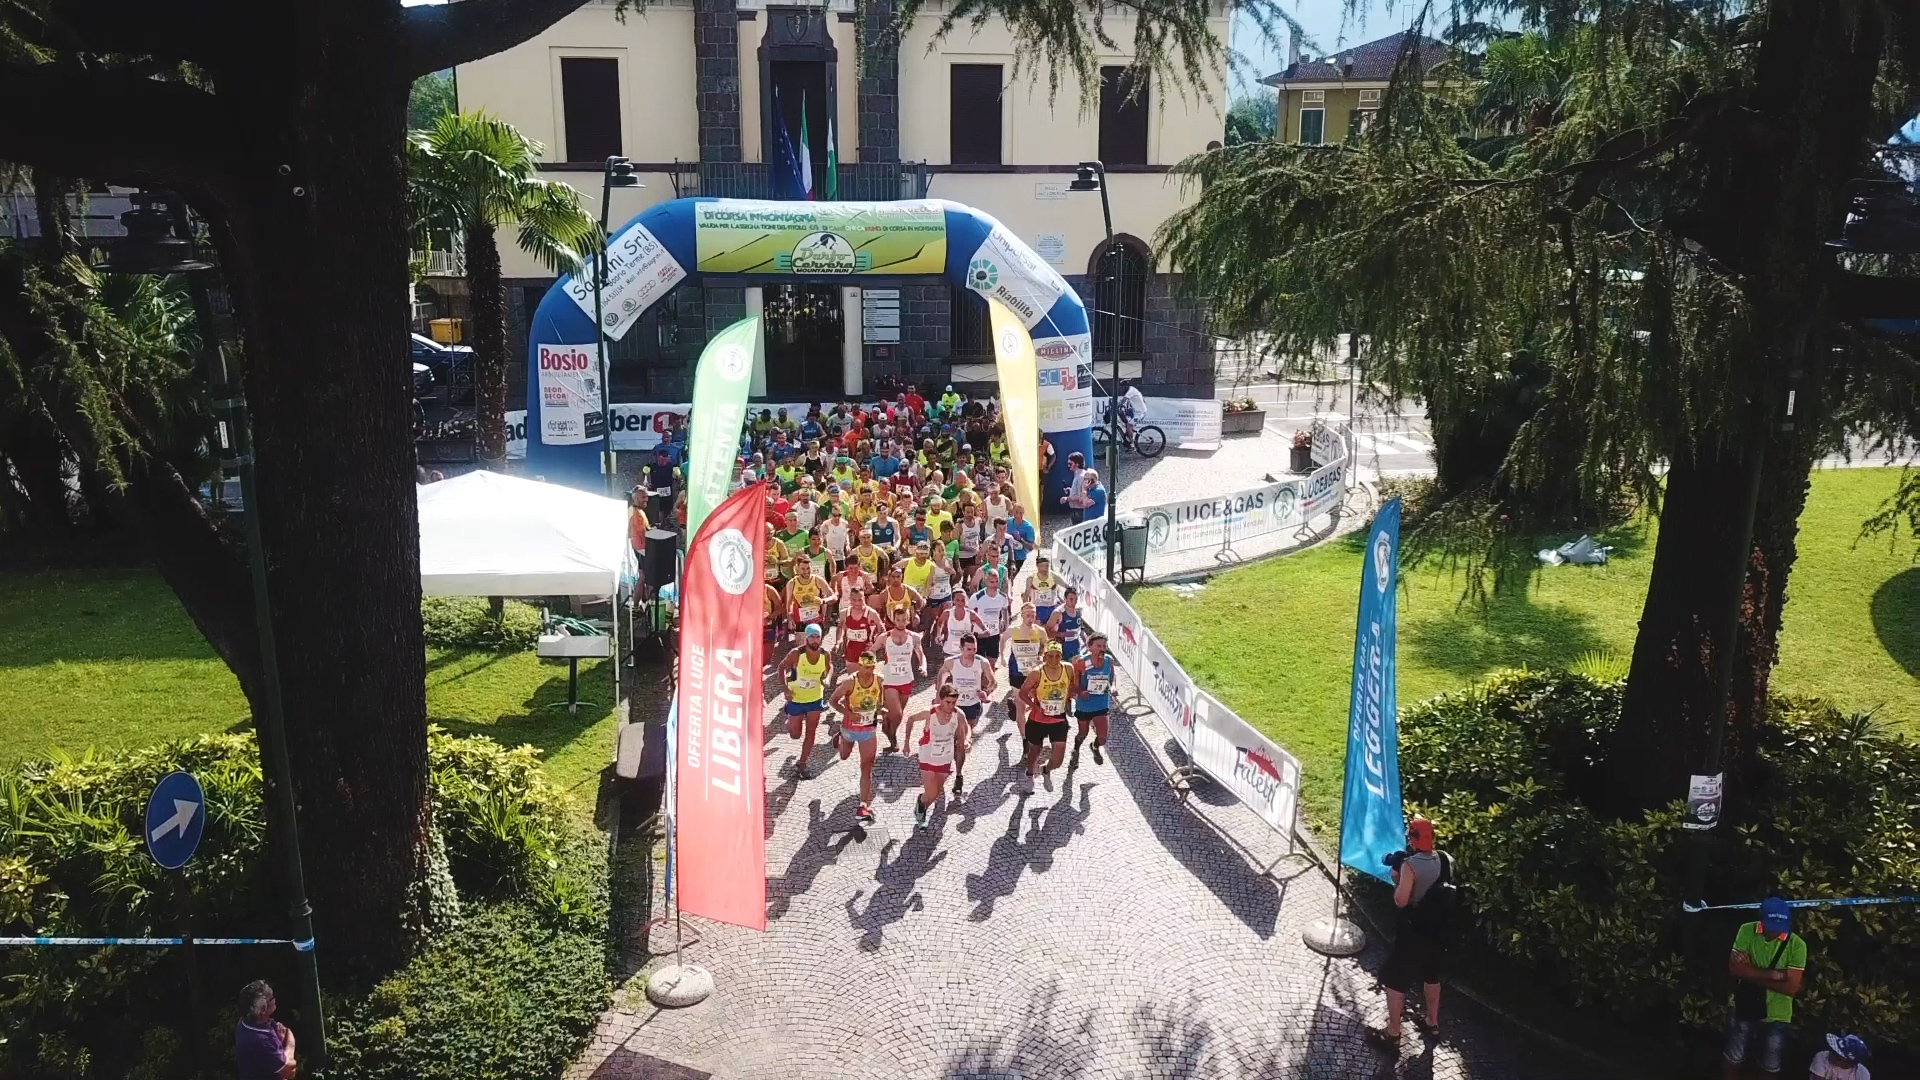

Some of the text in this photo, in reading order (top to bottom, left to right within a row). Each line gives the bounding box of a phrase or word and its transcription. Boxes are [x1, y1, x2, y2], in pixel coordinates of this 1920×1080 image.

[703, 211, 714, 220] DI
[715, 211, 748, 221] CORSA
[760, 212, 817, 224] MONTAGNA
[624, 229, 650, 255] Srl
[624, 253, 645, 269] Terme
[642, 240, 659, 256] (BS)
[800, 247, 850, 262] Darfo
[792, 257, 855, 268] Cervera
[996, 285, 1034, 319] Riabilita
[540, 347, 588, 371] Bosio
[610, 409, 652, 432] ber
[704, 403, 739, 508] ATTENTA
[1299, 467, 1341, 500] LUCE&GAS
[1176, 491, 1264, 525] LUCE&GAS
[1353, 633, 1368, 742] OFFERTA GAS
[687, 644, 705, 768] OFFERTA LUCE
[712, 648, 743, 795] LIBERA
[1364, 620, 1385, 800] LEGGERA
[1233, 745, 1282, 813] Faletti
